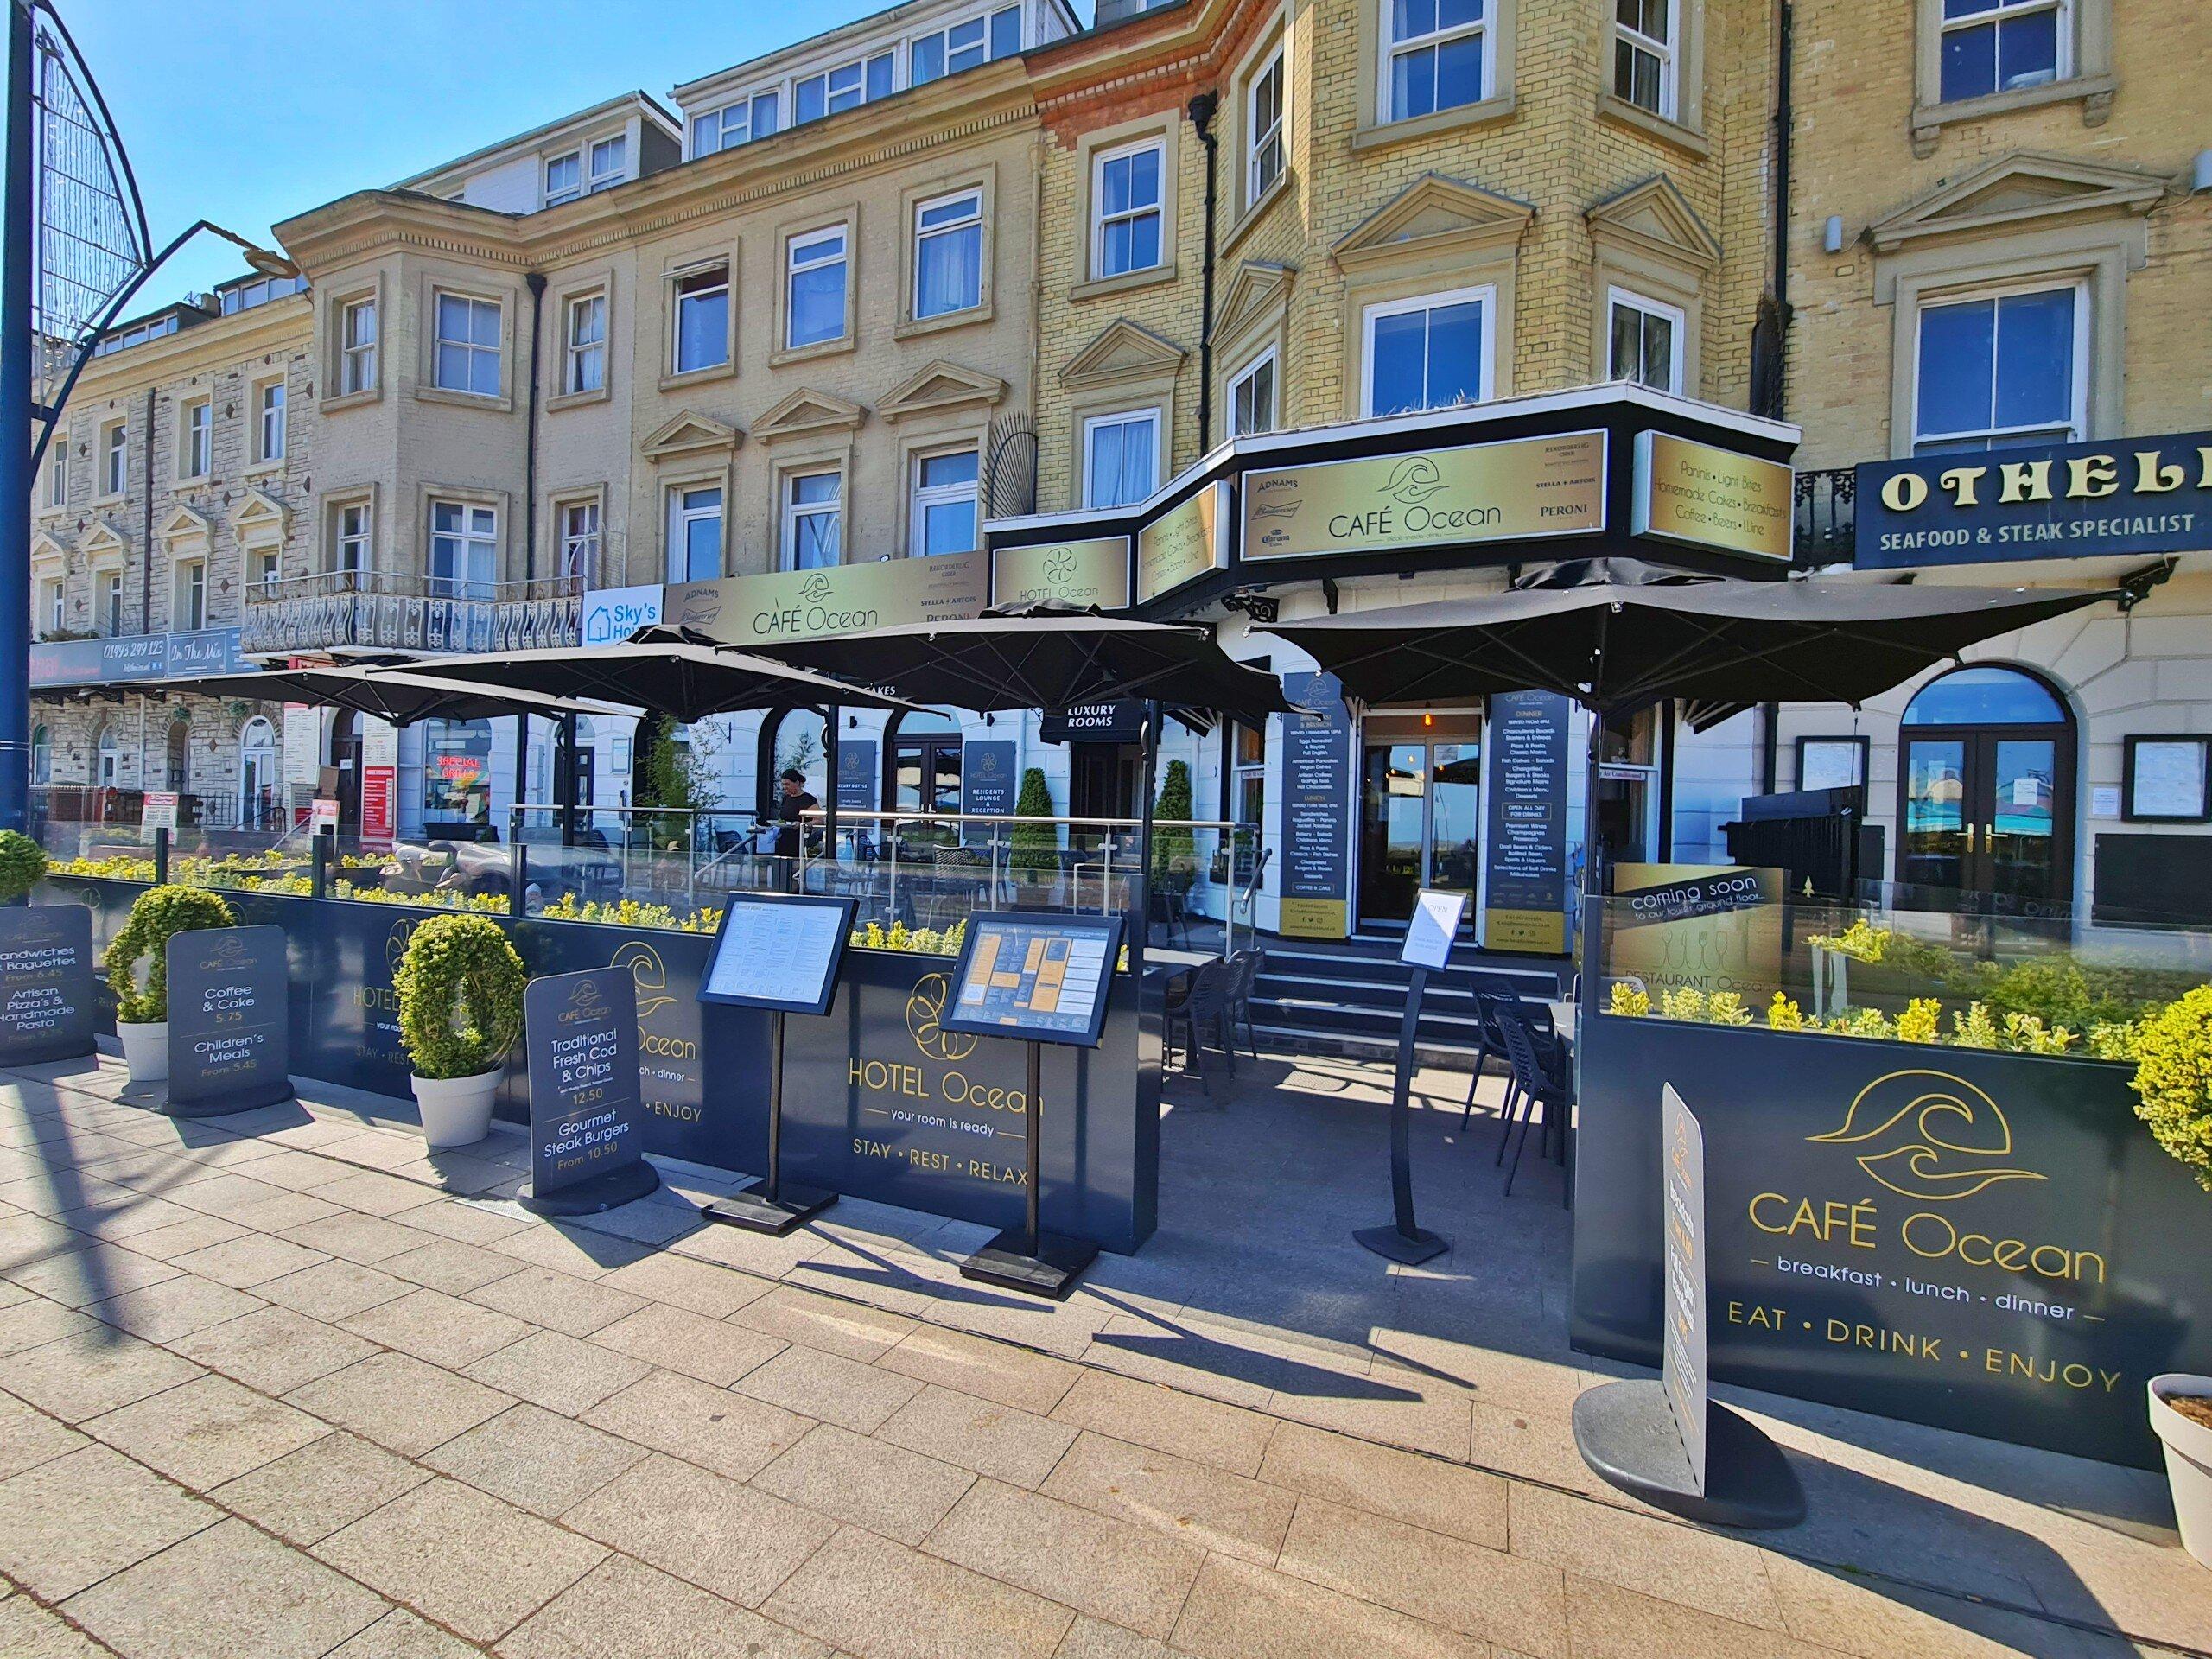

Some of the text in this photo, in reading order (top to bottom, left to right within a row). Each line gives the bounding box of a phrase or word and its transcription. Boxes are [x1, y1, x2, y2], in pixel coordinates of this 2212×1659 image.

[1681, 461, 1762, 492] Paninis Light Bites
[1257, 479, 1299, 493] ADNAMS
[1654, 478, 1786, 518] Homemade Cakes Breakfasts
[1541, 504, 1587, 517] PERONI
[1329, 506, 1501, 538] CAFÉ Ocean
[1675, 505, 1764, 536] Coffee Beers Wine
[1880, 513, 2195, 551] SEAFOOD & STEAK SPECIALIST
[683, 588, 719, 602] ADNAMS
[1058, 586, 1098, 597] Ocean
[753, 606, 878, 634] CAFÉ Ocean
[148, 639, 164, 656] 123
[184, 644, 202, 660] The
[865, 686, 895, 695] AKES
[1068, 704, 1116, 716] LUXURY
[1068, 717, 1113, 727] ROOMS
[1631, 876, 1757, 910] coming soon
[1428, 905, 1448, 913] OPEN
[1635, 912, 1646, 921] to
[1649, 909, 1664, 919] our
[1668, 905, 1693, 916] lower
[1697, 895, 1734, 912] ground
[0, 947, 74, 960] andwiches
[7, 957, 76, 970] Baguettes
[12, 987, 59, 1000] Artisan
[53, 995, 63, 1005] &
[204, 985, 252, 1000] Coffee
[353, 986, 400, 1012] HOTEL
[203, 996, 255, 1012] & Cake
[16, 1019, 54, 1031] Pasta
[216, 1012, 242, 1023] 5.75
[376, 1021, 391, 1032] your
[551, 1027, 617, 1054] Traditional
[209, 1047, 251, 1064] Meals
[356, 1044, 378, 1058] STAY
[553, 1043, 617, 1070] Fresh Cod
[233, 1059, 257, 1071] 5.45
[562, 1061, 611, 1083] & Chips
[657, 1069, 685, 1082] dinner
[849, 1058, 930, 1099] HOTEL
[572, 1088, 603, 1106] 12.50
[655, 1101, 702, 1122] ENJOY
[558, 1109, 617, 1137] Gourmet
[890, 1109, 995, 1138] your room is ready
[543, 1122, 629, 1158] Steak Burgers
[557, 1141, 618, 1171] From 10.50
[853, 1138, 1028, 1185] STAY REST RELAX
[1748, 1192, 1877, 1249] CAFÉ
[1902, 1212, 2105, 1284] Ocean
[1777, 1255, 2075, 1320] breakfast lunch dinner
[1729, 1300, 2121, 1393] EAT DRINK ENJOY
